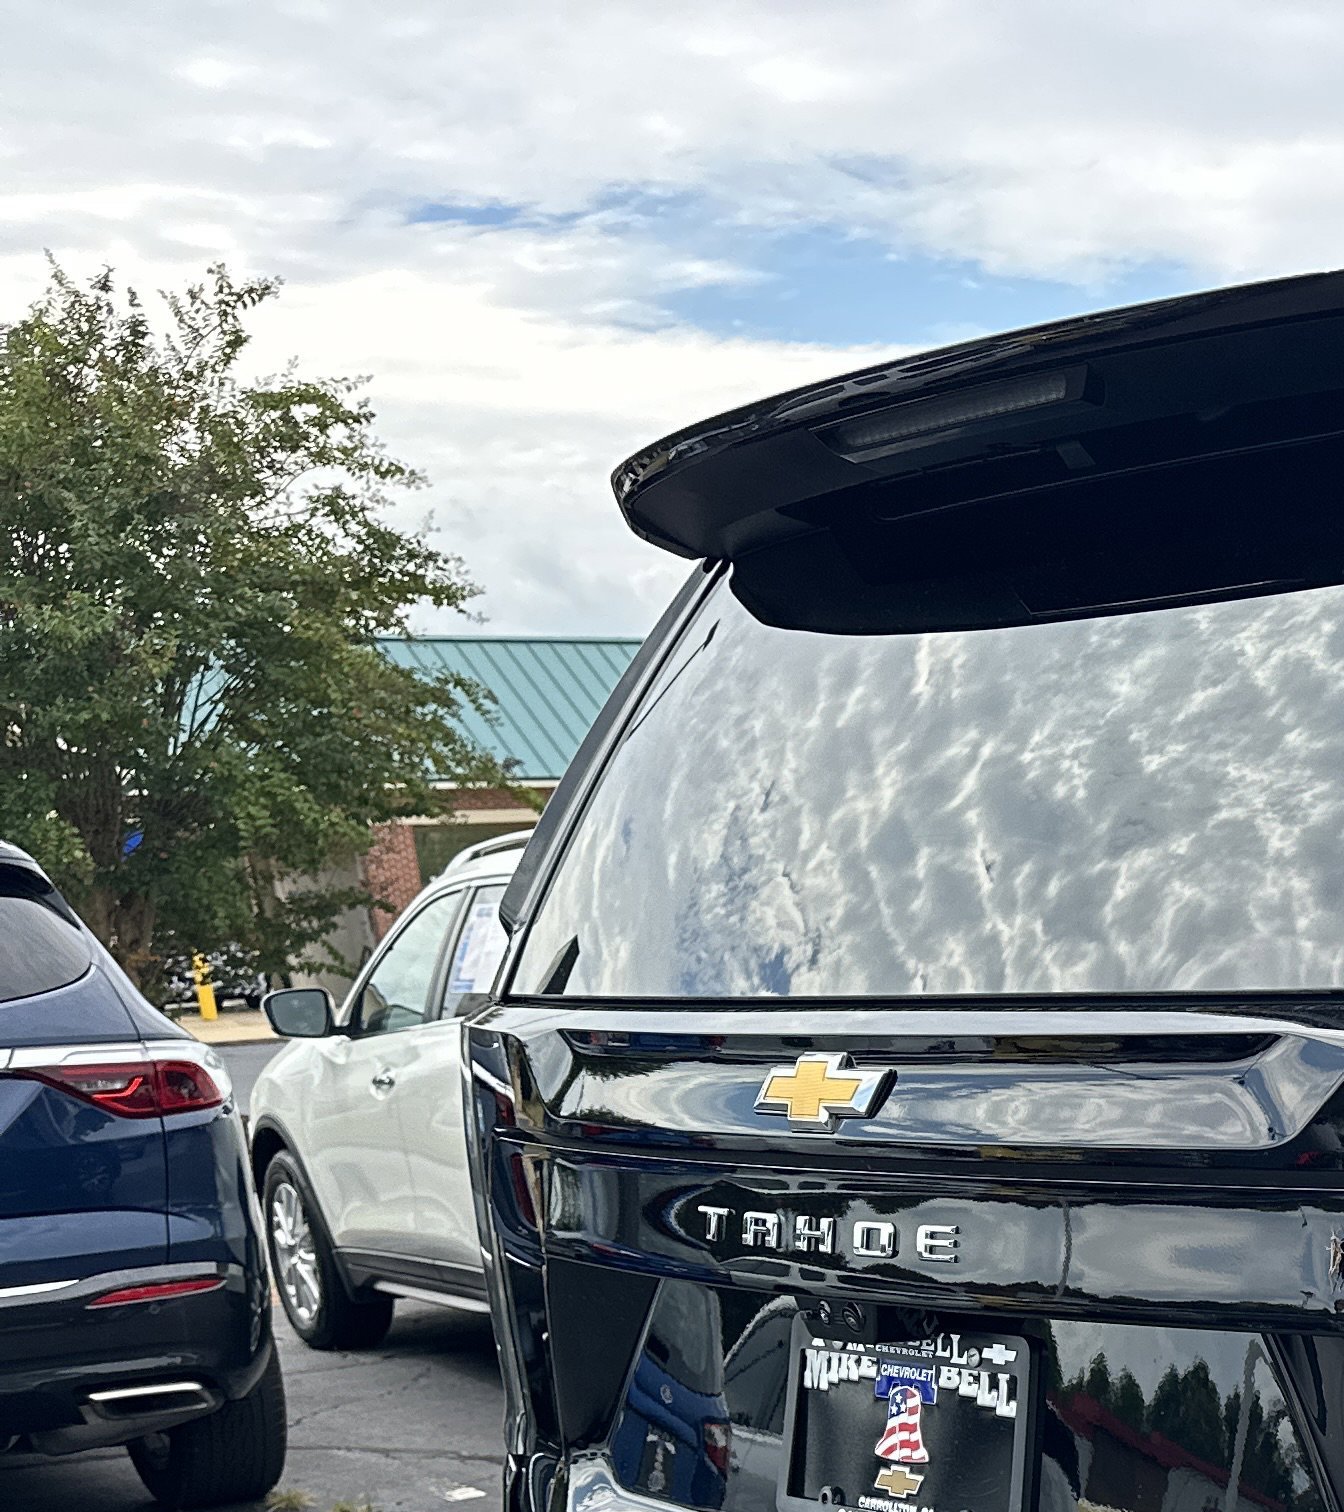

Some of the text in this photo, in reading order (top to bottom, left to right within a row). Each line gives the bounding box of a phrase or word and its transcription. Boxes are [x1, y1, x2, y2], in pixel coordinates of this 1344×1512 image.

[698, 1205, 960, 1264] TAHOE
[875, 1343, 935, 1359] CHEVROLET
[803, 1348, 1018, 1418] MIKE BELL
[881, 1363, 935, 1383] CHEVROLET
